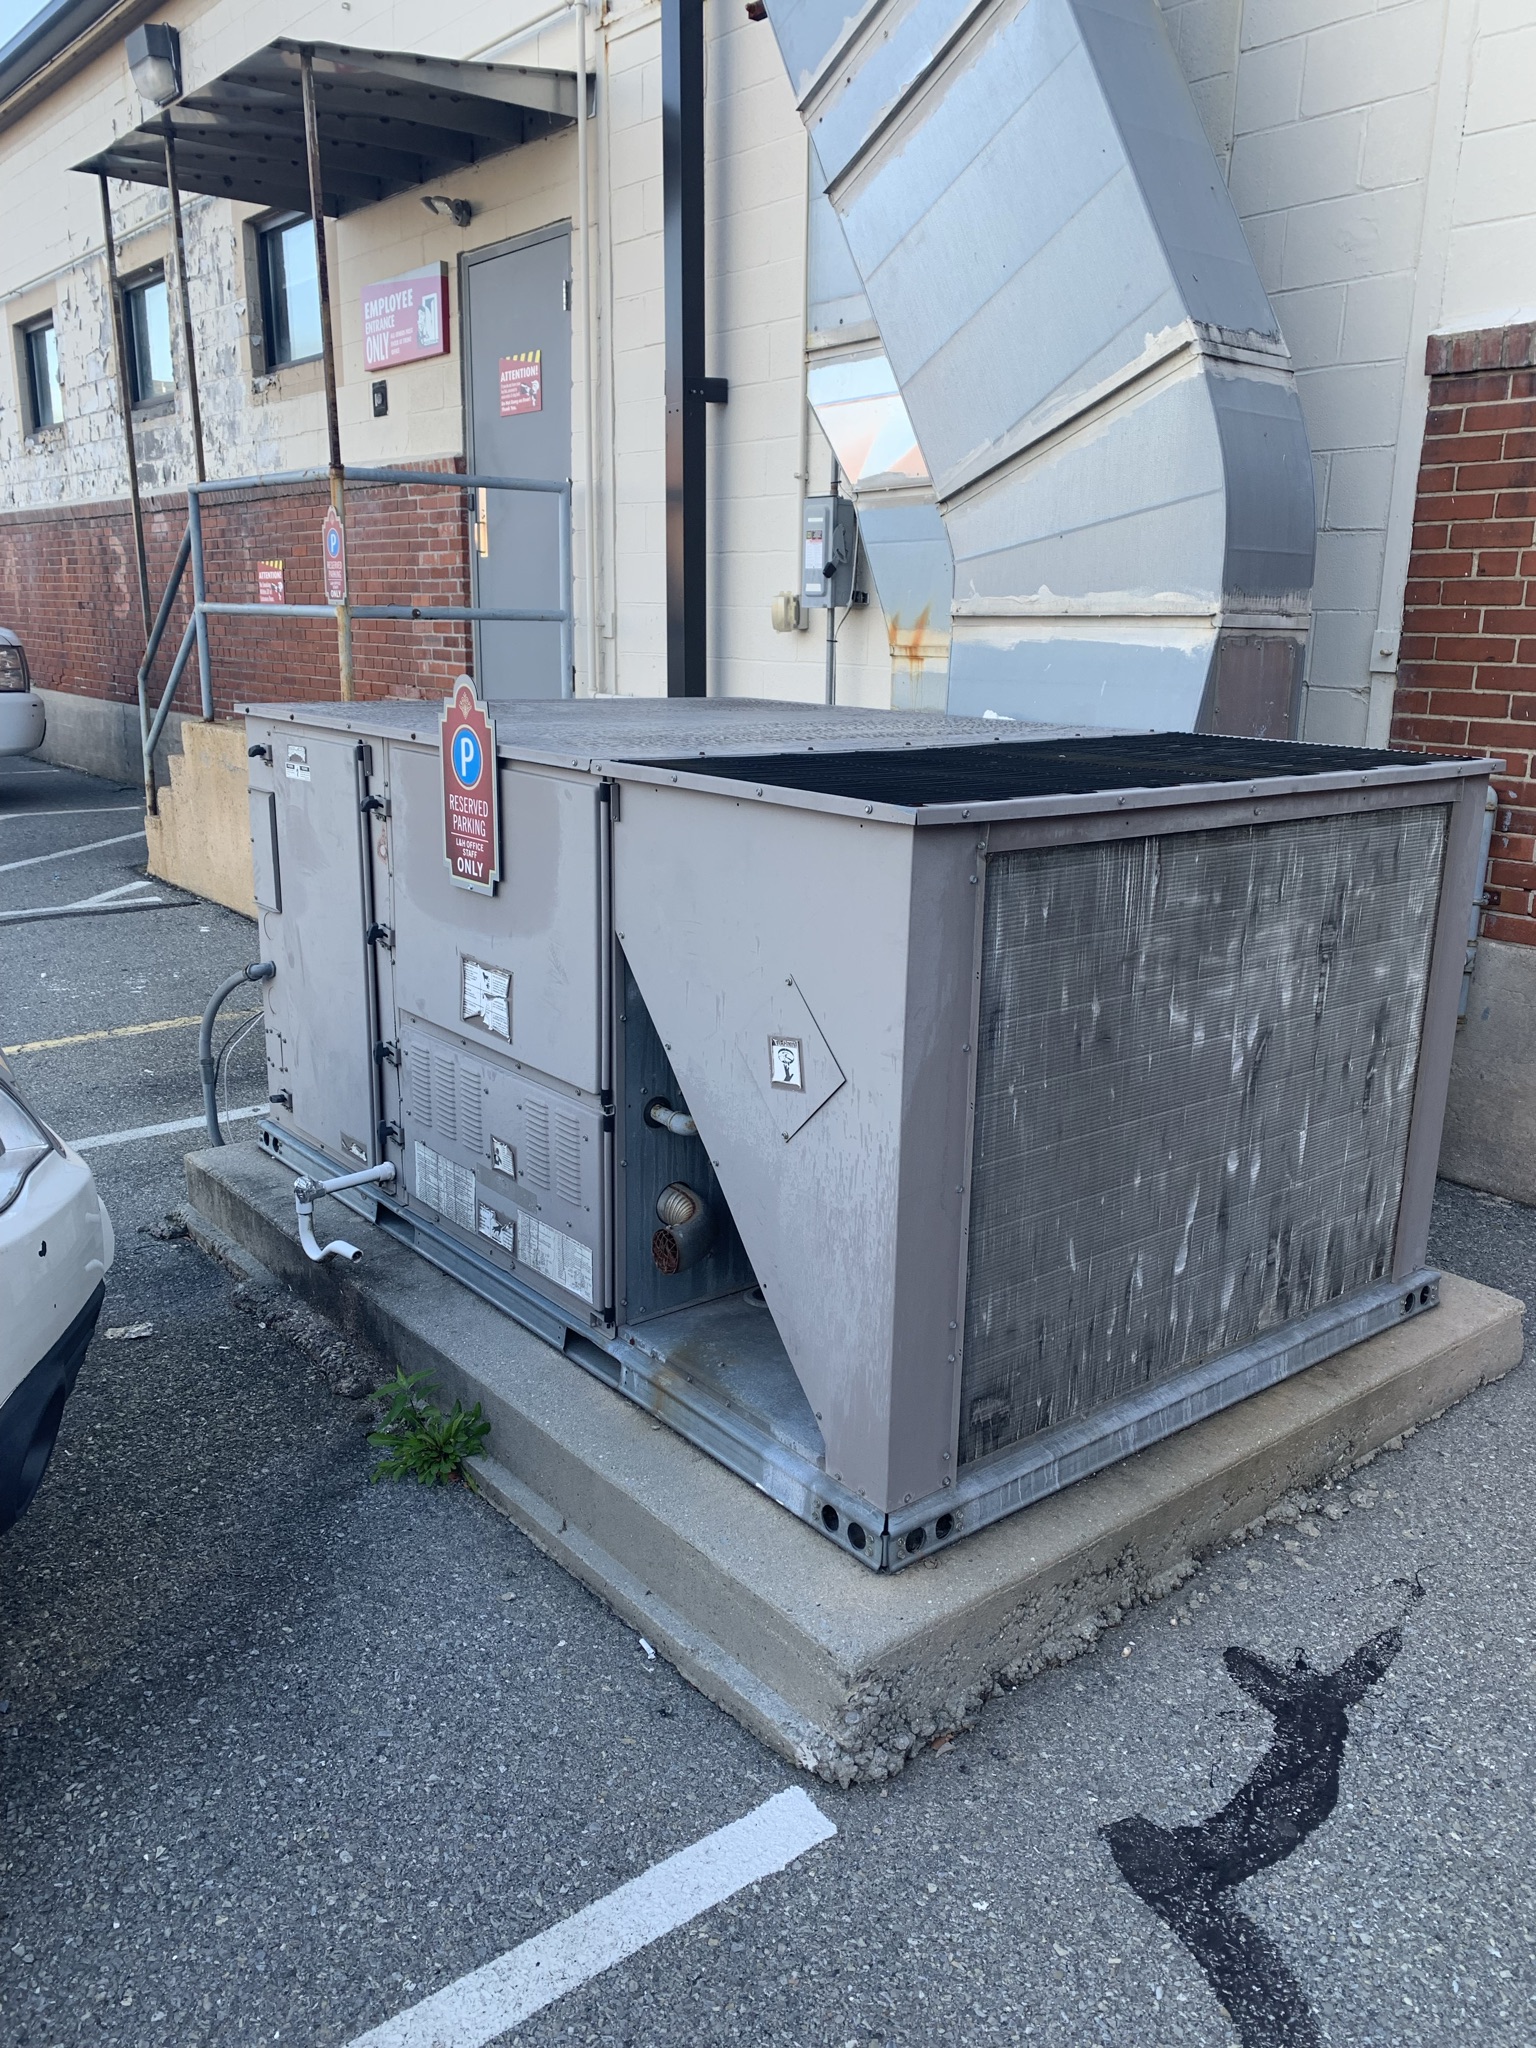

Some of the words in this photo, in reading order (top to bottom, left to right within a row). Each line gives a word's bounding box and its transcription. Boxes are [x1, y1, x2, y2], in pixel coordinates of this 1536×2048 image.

[364, 288, 413, 320] EMPLOYEE
[365, 314, 395, 335] ENTRANCE
[366, 331, 389, 364] ONLY
[500, 365, 539, 383] ATTENTION!
[330, 533, 336, 553] P
[460, 737, 474, 777] P
[449, 794, 489, 818] RESERVED
[452, 813, 486, 837] PARKING
[455, 837, 466, 848] L&H
[466, 841, 484, 852] OFFICE
[462, 848, 478, 859] STAFF
[457, 856, 484, 877] ONLY
